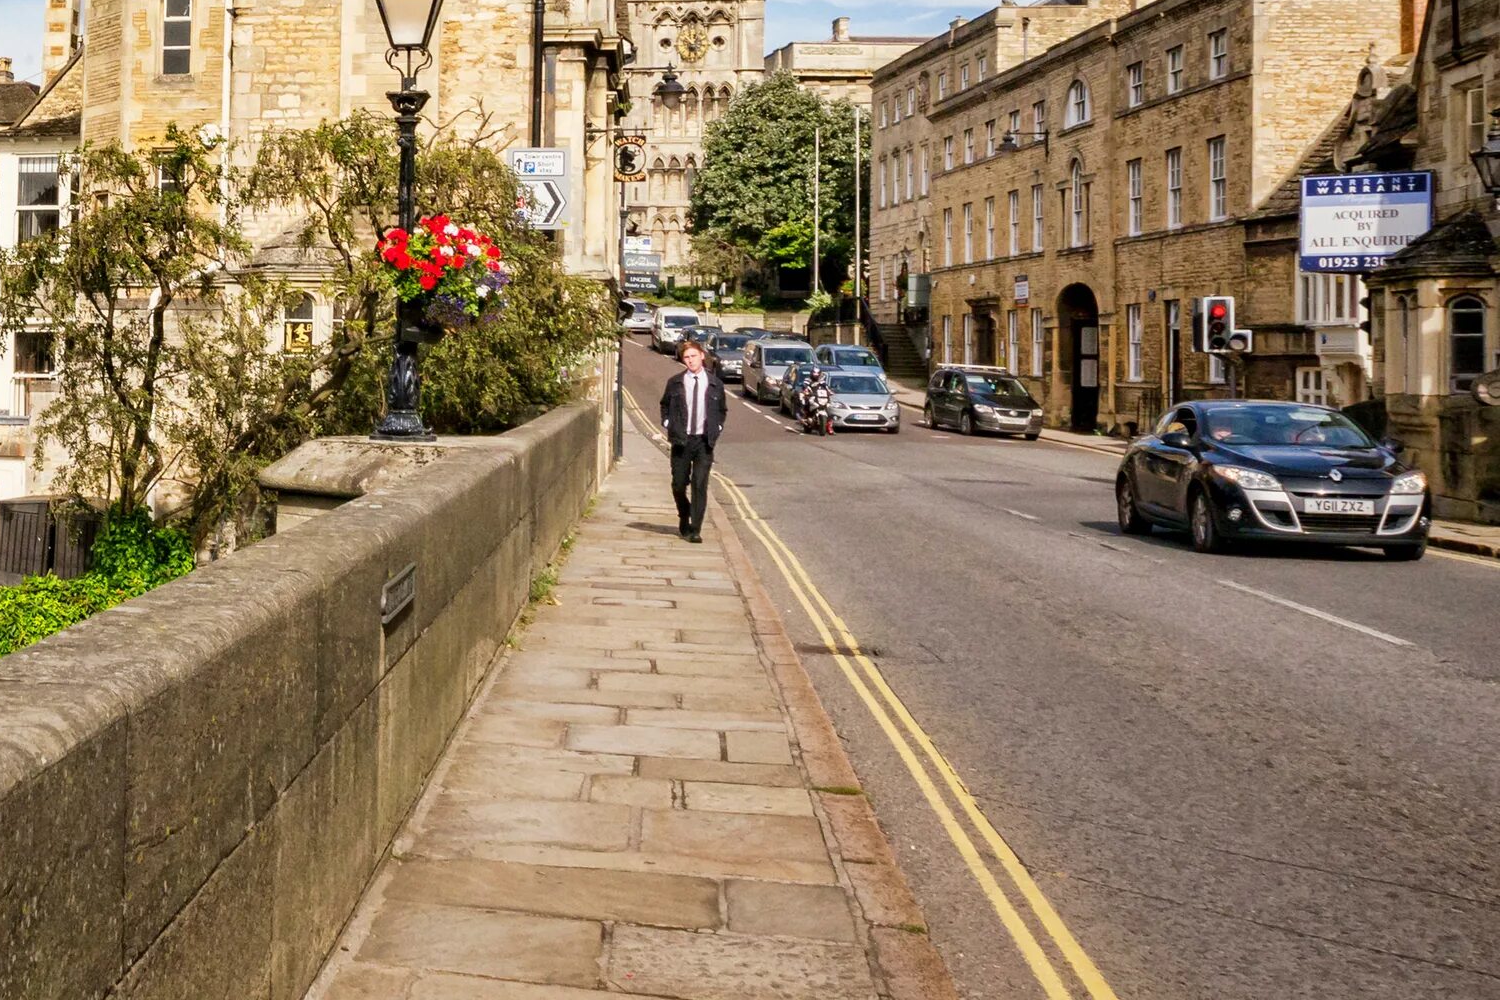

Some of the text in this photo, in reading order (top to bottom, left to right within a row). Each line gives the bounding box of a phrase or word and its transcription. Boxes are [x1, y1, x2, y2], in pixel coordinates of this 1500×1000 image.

[1317, 176, 1415, 187] WARRANT
[1317, 184, 1415, 194] WARRANT
[1332, 209, 1399, 220] ACQUIRED
[1357, 222, 1373, 231] BY
[1310, 237, 1338, 248] ALL
[1319, 256, 1358, 268] 01923
